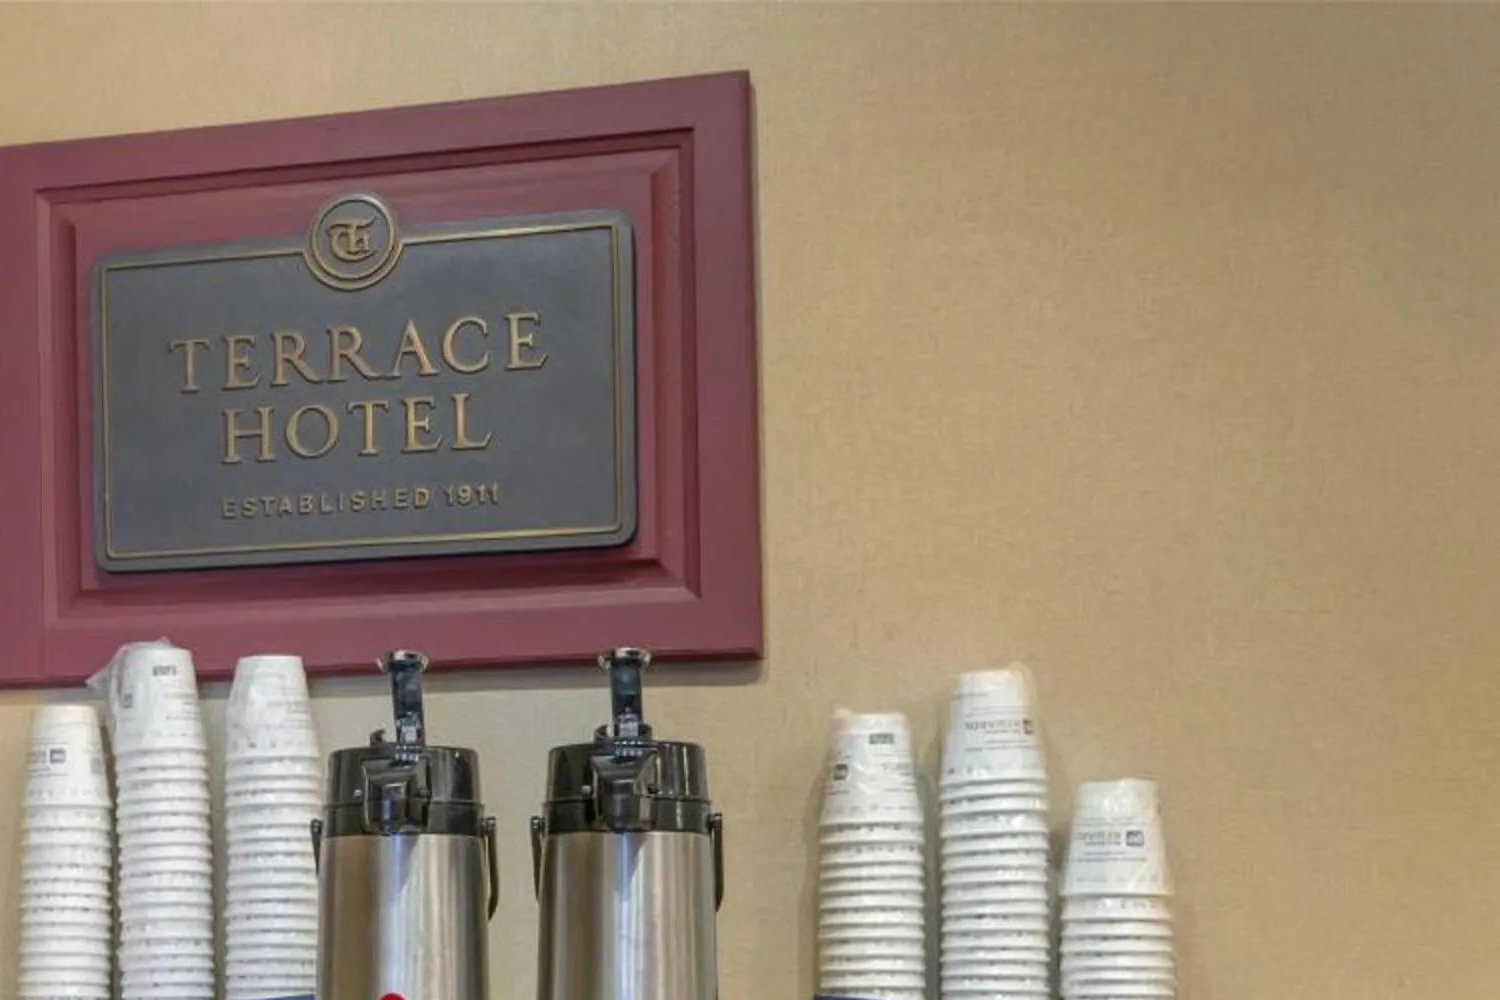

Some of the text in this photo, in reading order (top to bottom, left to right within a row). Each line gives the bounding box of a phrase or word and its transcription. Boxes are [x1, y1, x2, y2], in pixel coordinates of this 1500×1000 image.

[168, 311, 548, 394] TERRACE
[220, 392, 492, 464] HOTEL
[221, 483, 498, 519] ESTABLISHED 1911
